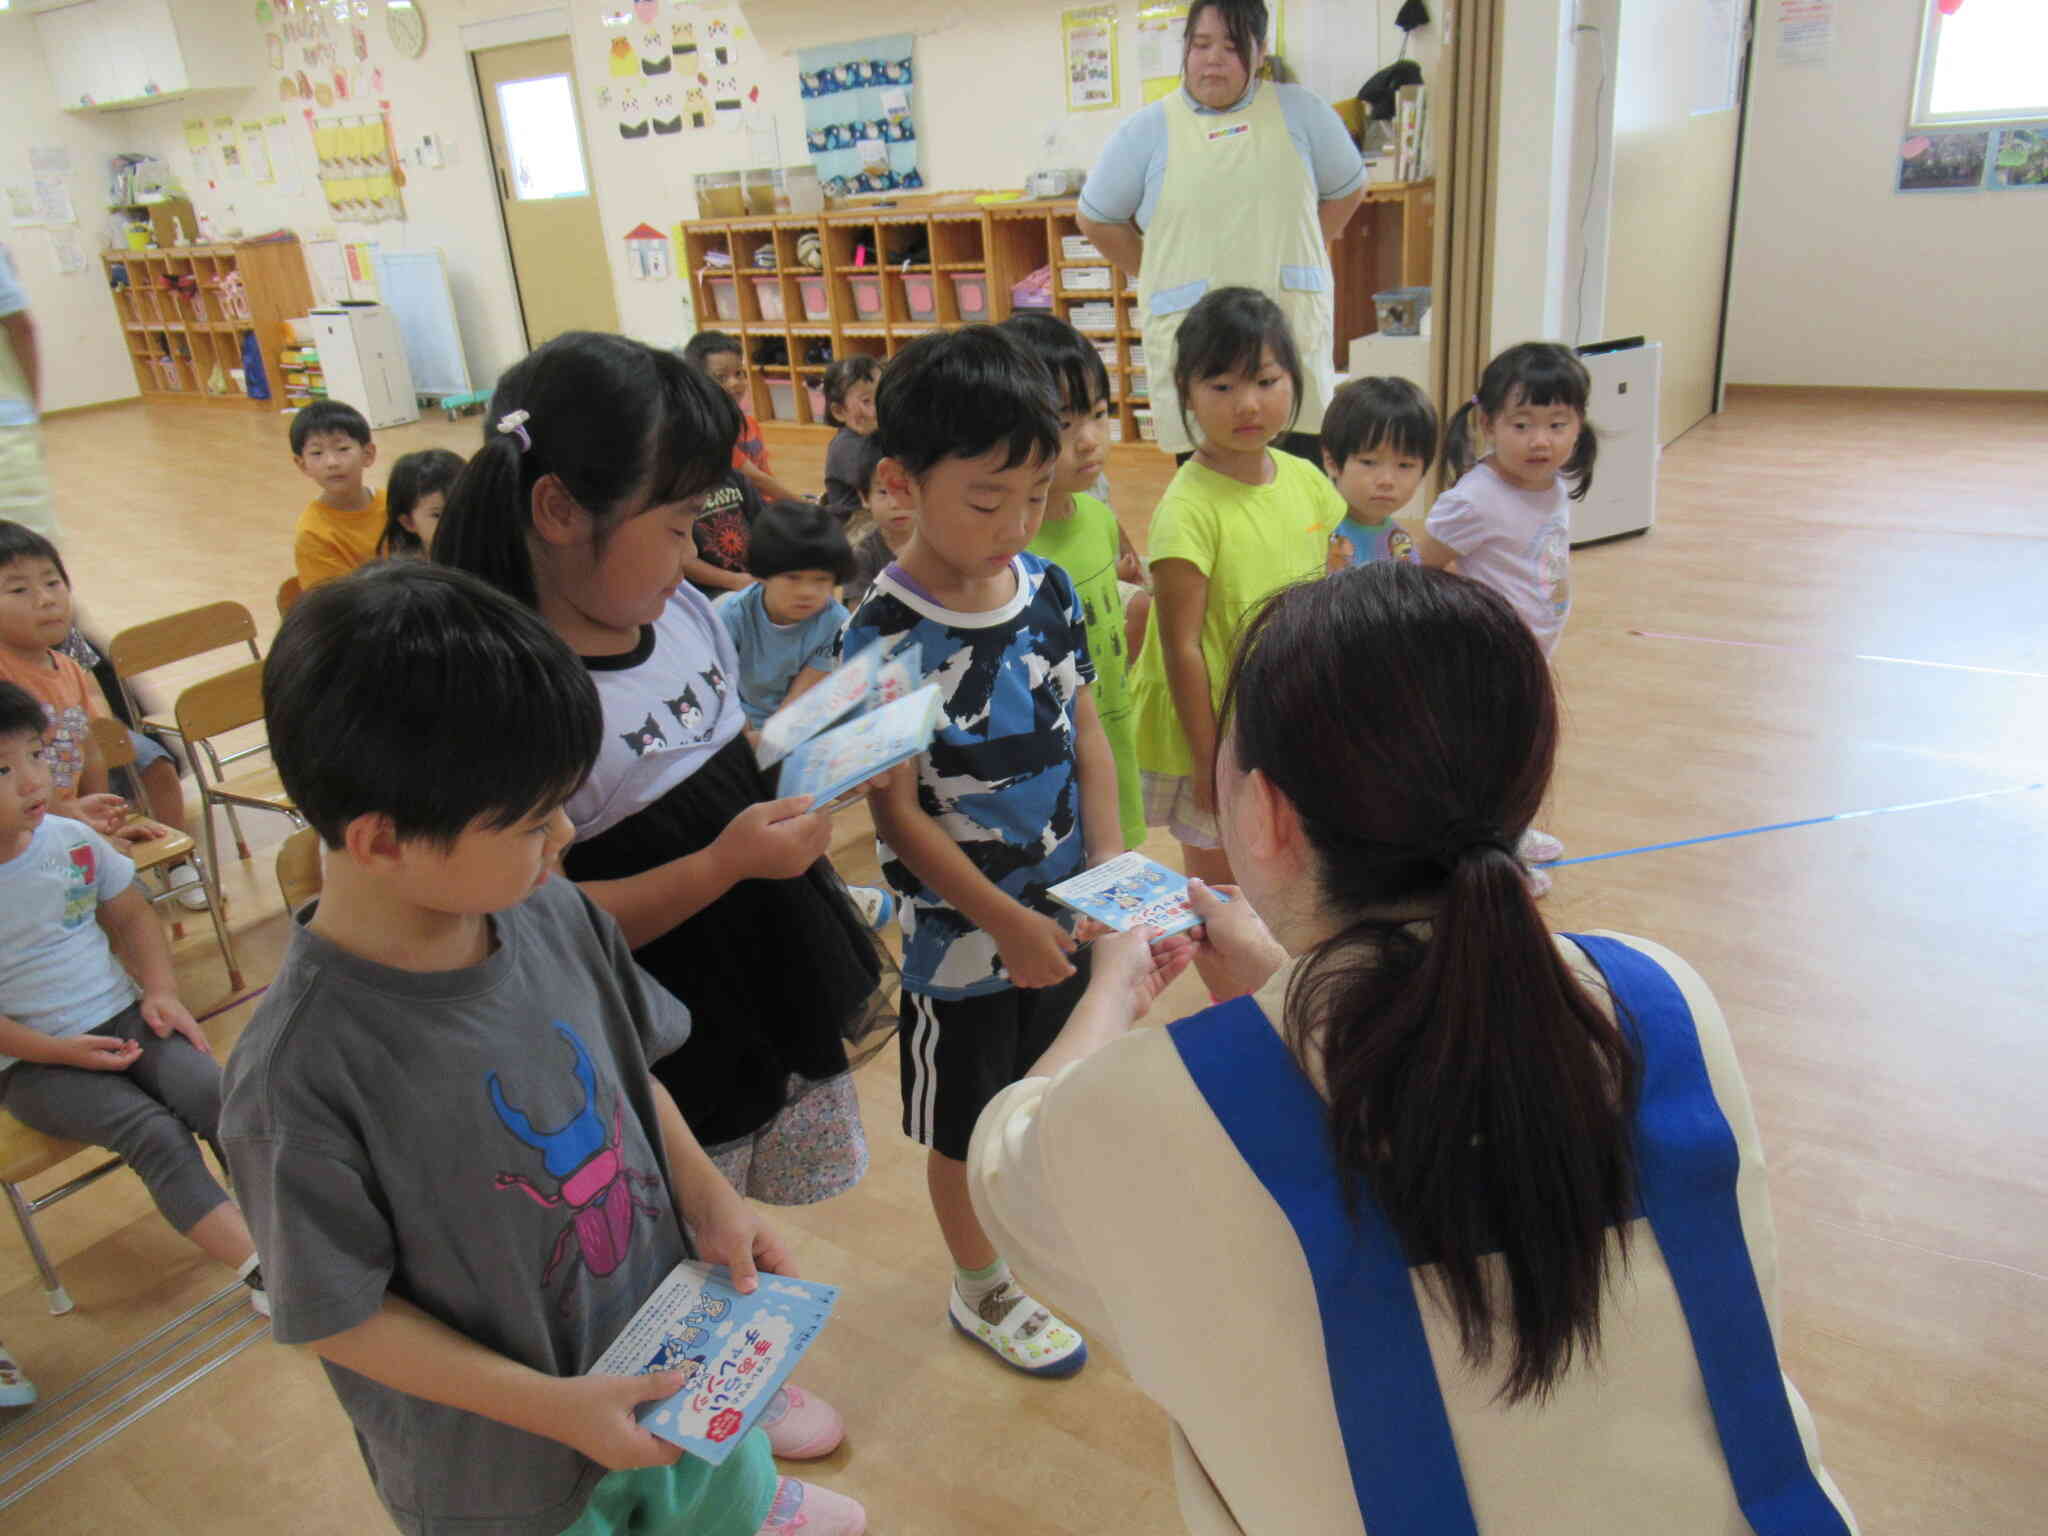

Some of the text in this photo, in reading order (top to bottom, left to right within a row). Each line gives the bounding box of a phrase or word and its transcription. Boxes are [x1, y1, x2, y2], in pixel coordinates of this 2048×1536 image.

[693, 1329, 760, 1413] チャレンジ
